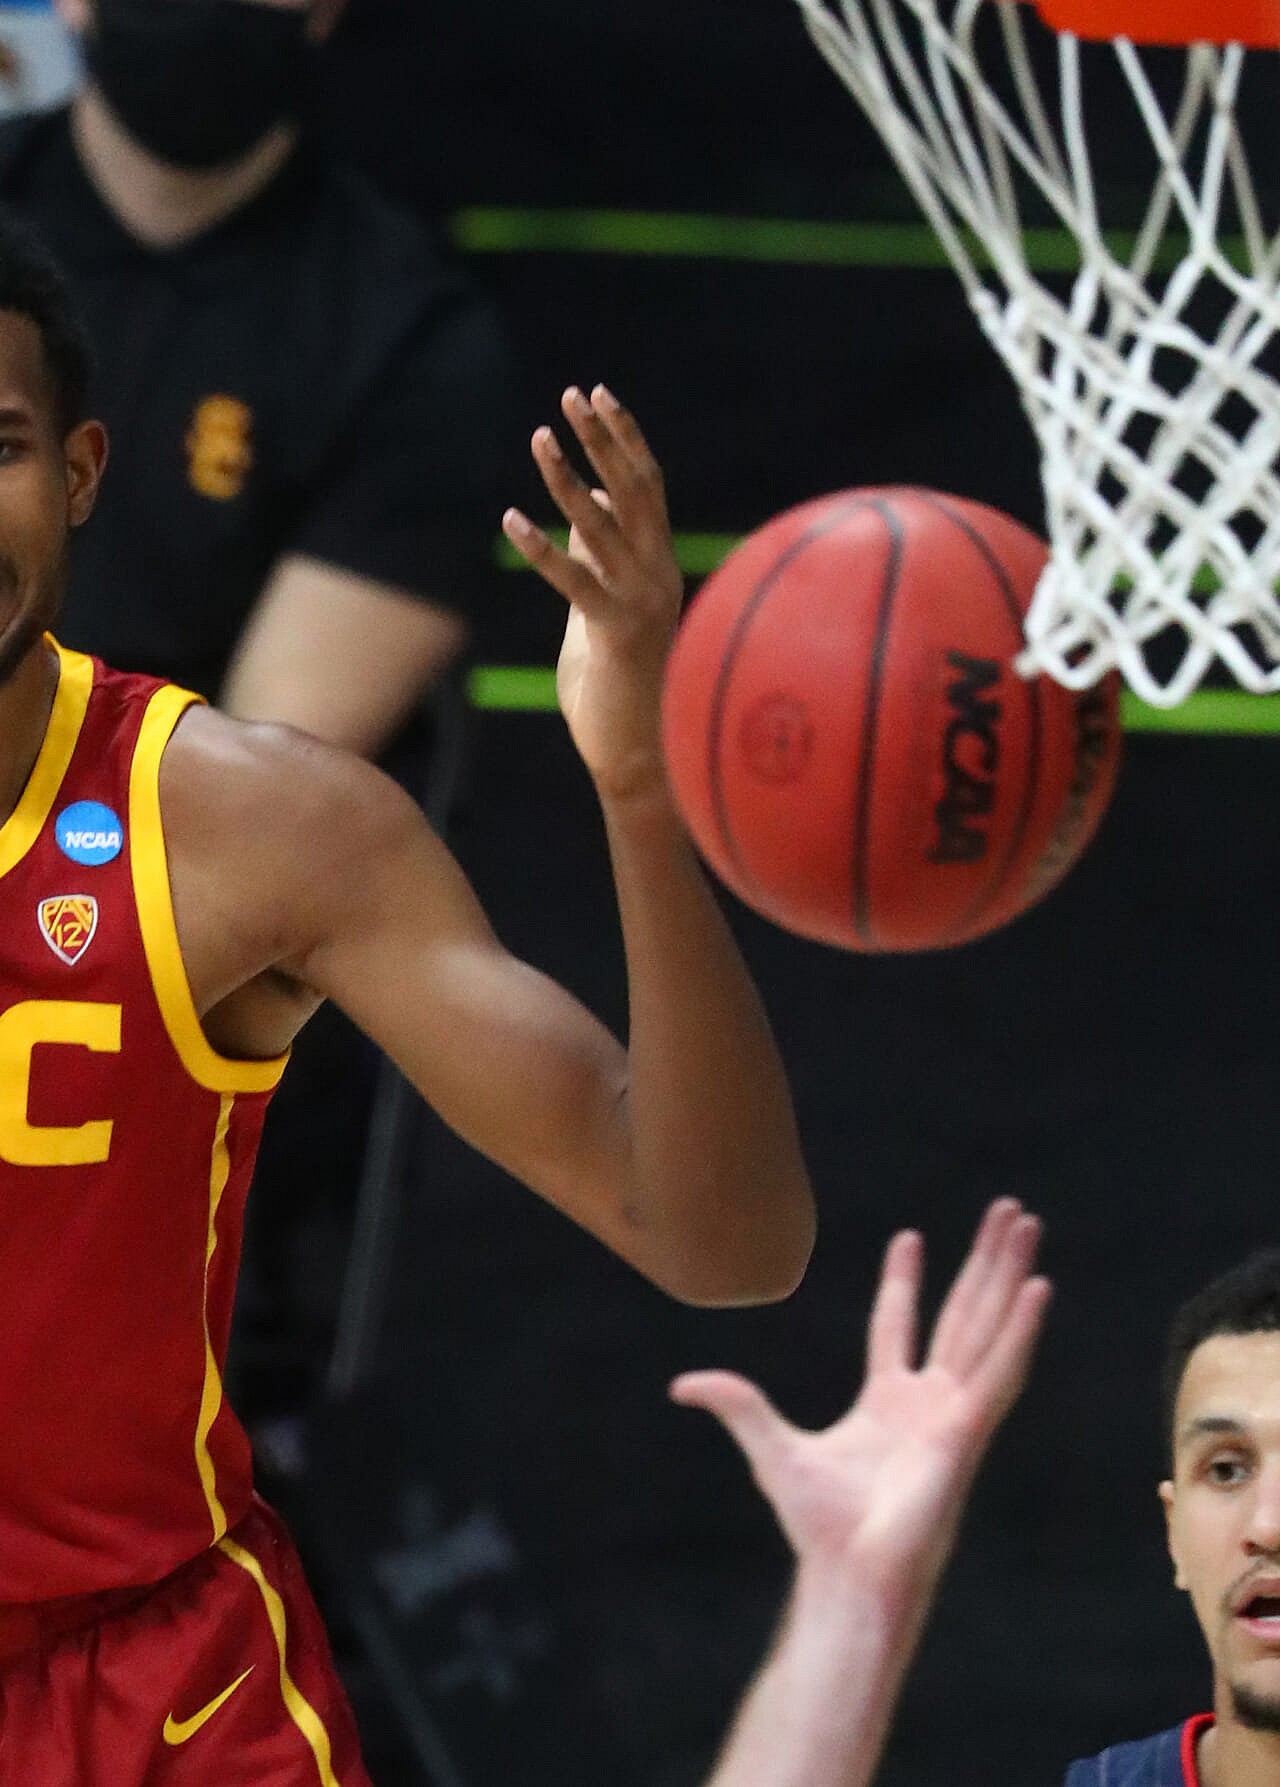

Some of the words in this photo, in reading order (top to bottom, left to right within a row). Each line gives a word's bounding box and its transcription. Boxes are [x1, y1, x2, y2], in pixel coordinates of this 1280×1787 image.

[925, 651, 1002, 864] NCAA
[65, 831, 120, 849] NCAA
[42, 899, 93, 933] PAC
[56, 922, 84, 947] 12
